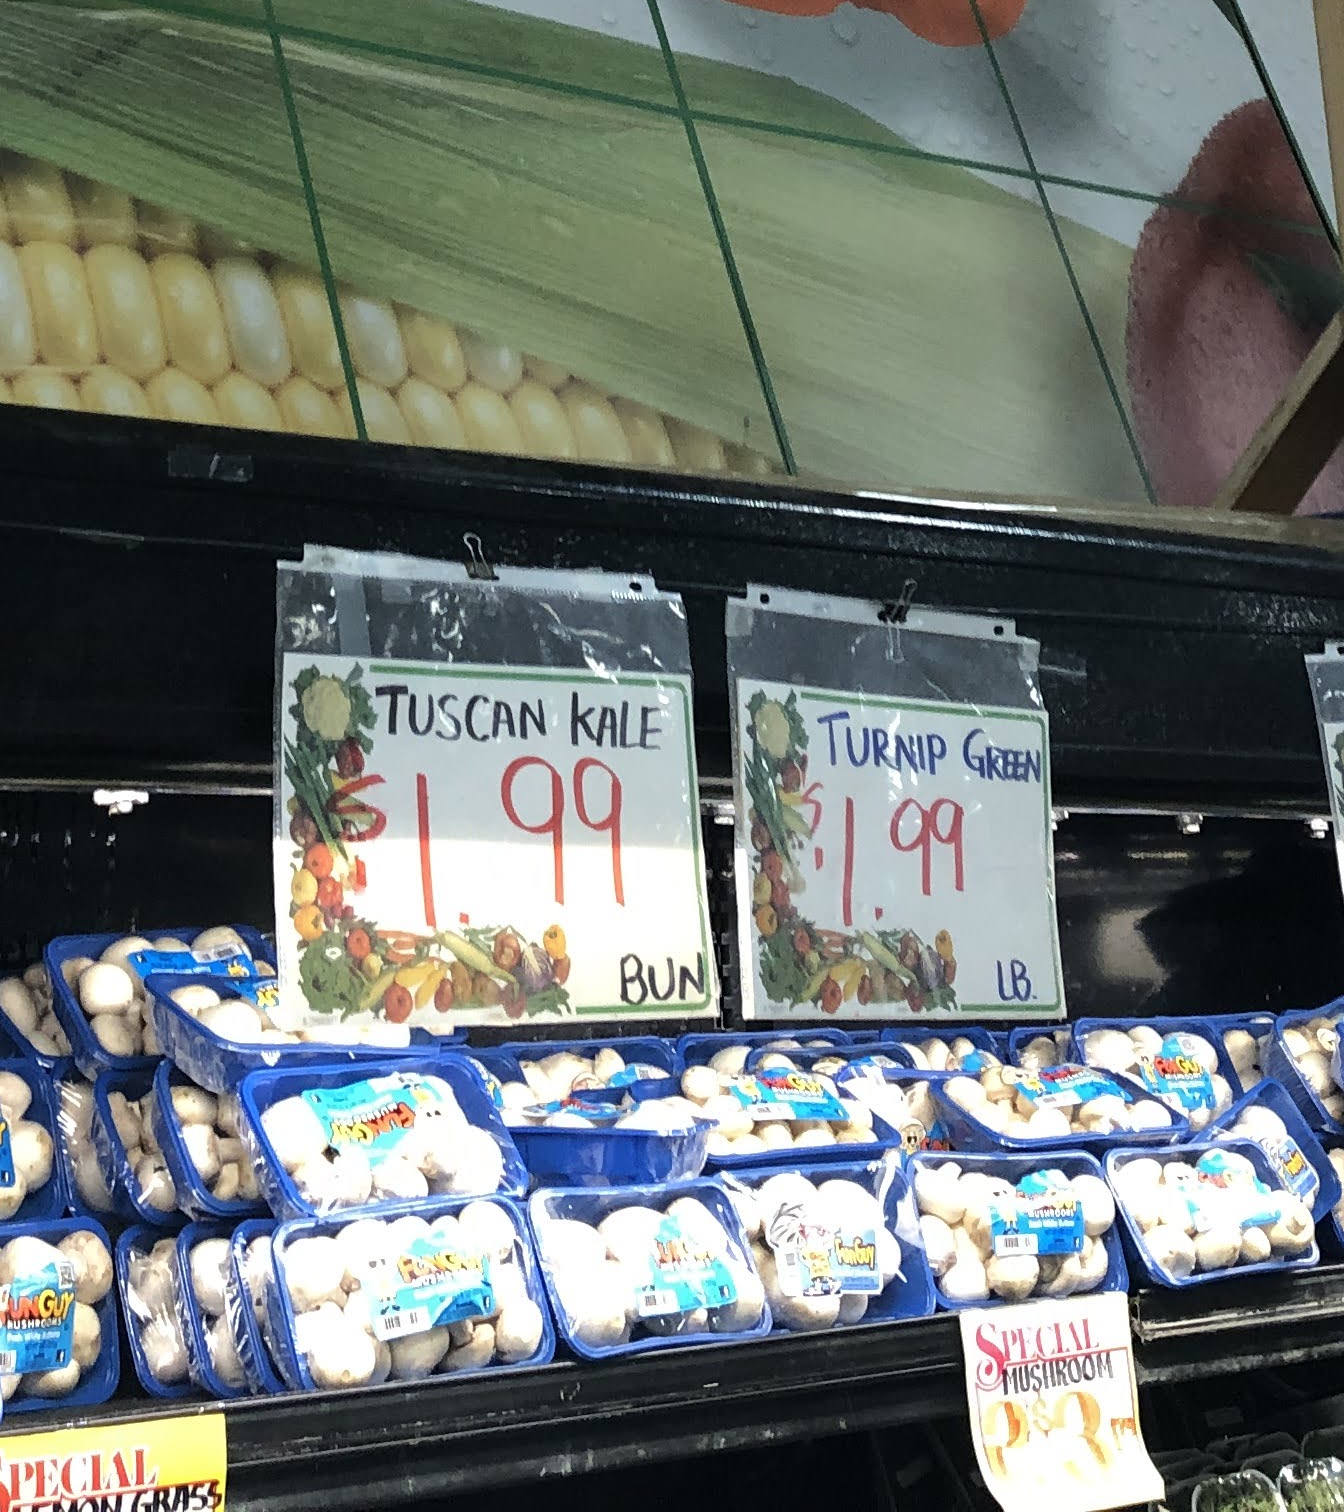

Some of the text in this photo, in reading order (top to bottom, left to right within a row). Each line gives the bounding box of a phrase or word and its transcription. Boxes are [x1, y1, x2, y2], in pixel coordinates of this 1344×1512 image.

[375, 684, 664, 752] TUSCAN KALE
[817, 710, 1042, 785] TURNIP GREEN
[618, 951, 706, 1006] BUN
[6, 1317, 63, 1331] MUSHROOMS
[975, 1317, 1101, 1387] SPECIAL
[1002, 1350, 1114, 1396] MUSHROOM
